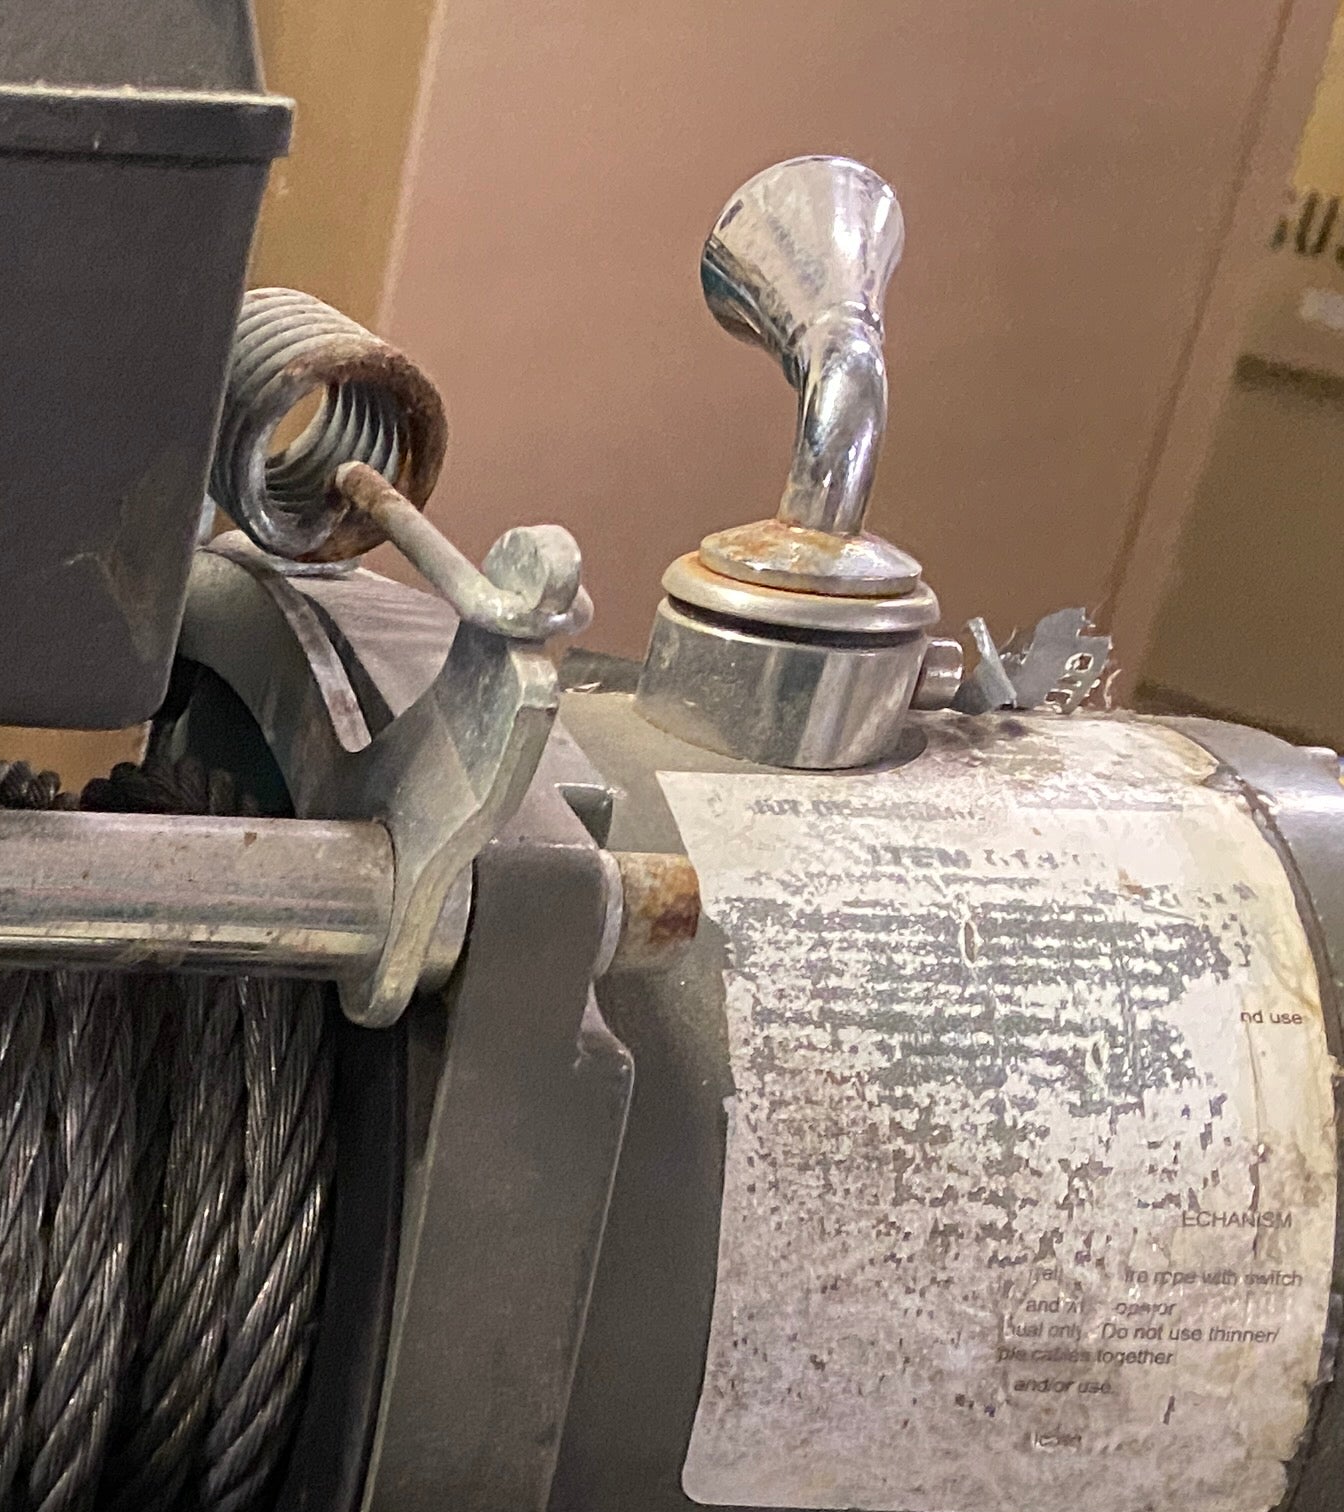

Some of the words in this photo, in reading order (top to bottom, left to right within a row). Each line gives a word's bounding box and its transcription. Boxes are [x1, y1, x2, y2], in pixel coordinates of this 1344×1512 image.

[1269, 1012, 1303, 1025] use
[1101, 1323, 1129, 1340] Do
[1133, 1325, 1164, 1341] not
[1169, 1328, 1203, 1342] use
[1096, 1349, 1174, 1367] together
